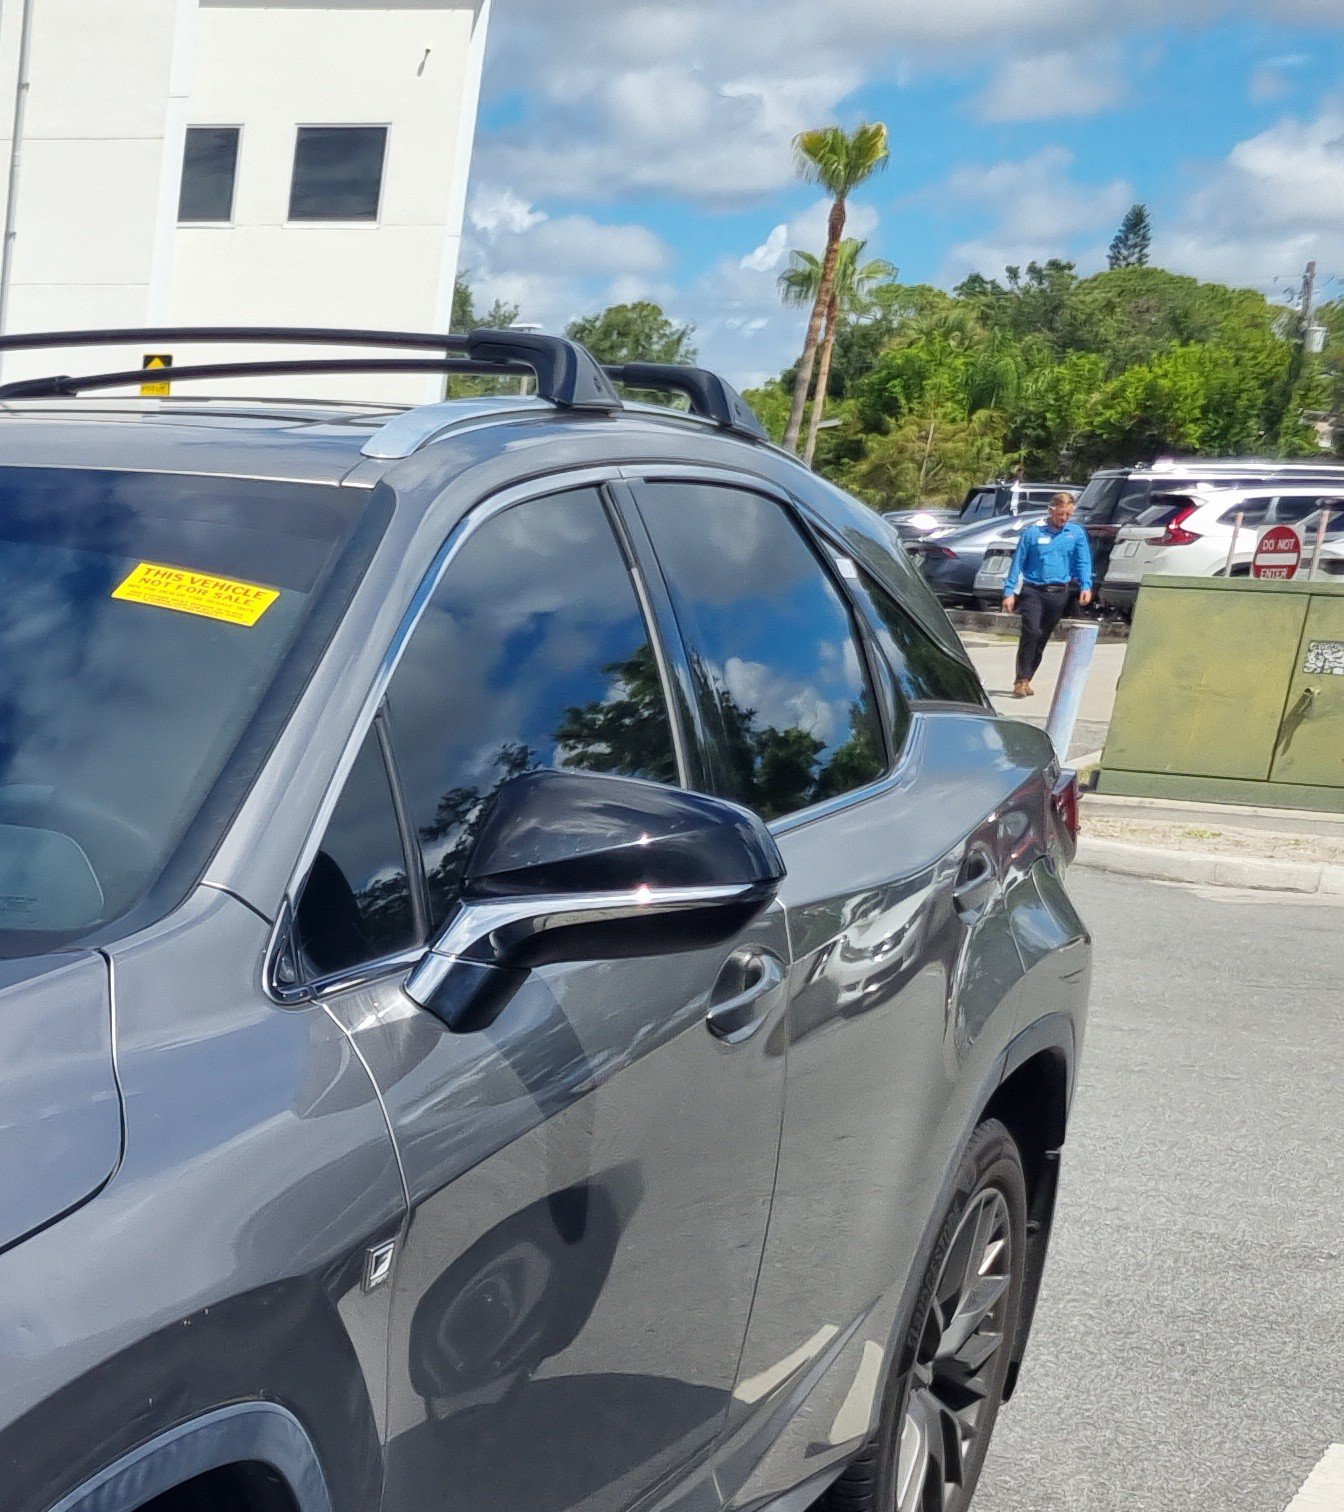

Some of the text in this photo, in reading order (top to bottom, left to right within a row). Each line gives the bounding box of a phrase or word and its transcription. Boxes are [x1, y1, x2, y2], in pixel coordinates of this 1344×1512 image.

[1262, 538, 1295, 551] DO NOT
[144, 568, 184, 582] THIS
[189, 577, 267, 600] VEHICLE
[1260, 568, 1287, 579] ENTER
[138, 577, 255, 606] NOT FOR SALE
